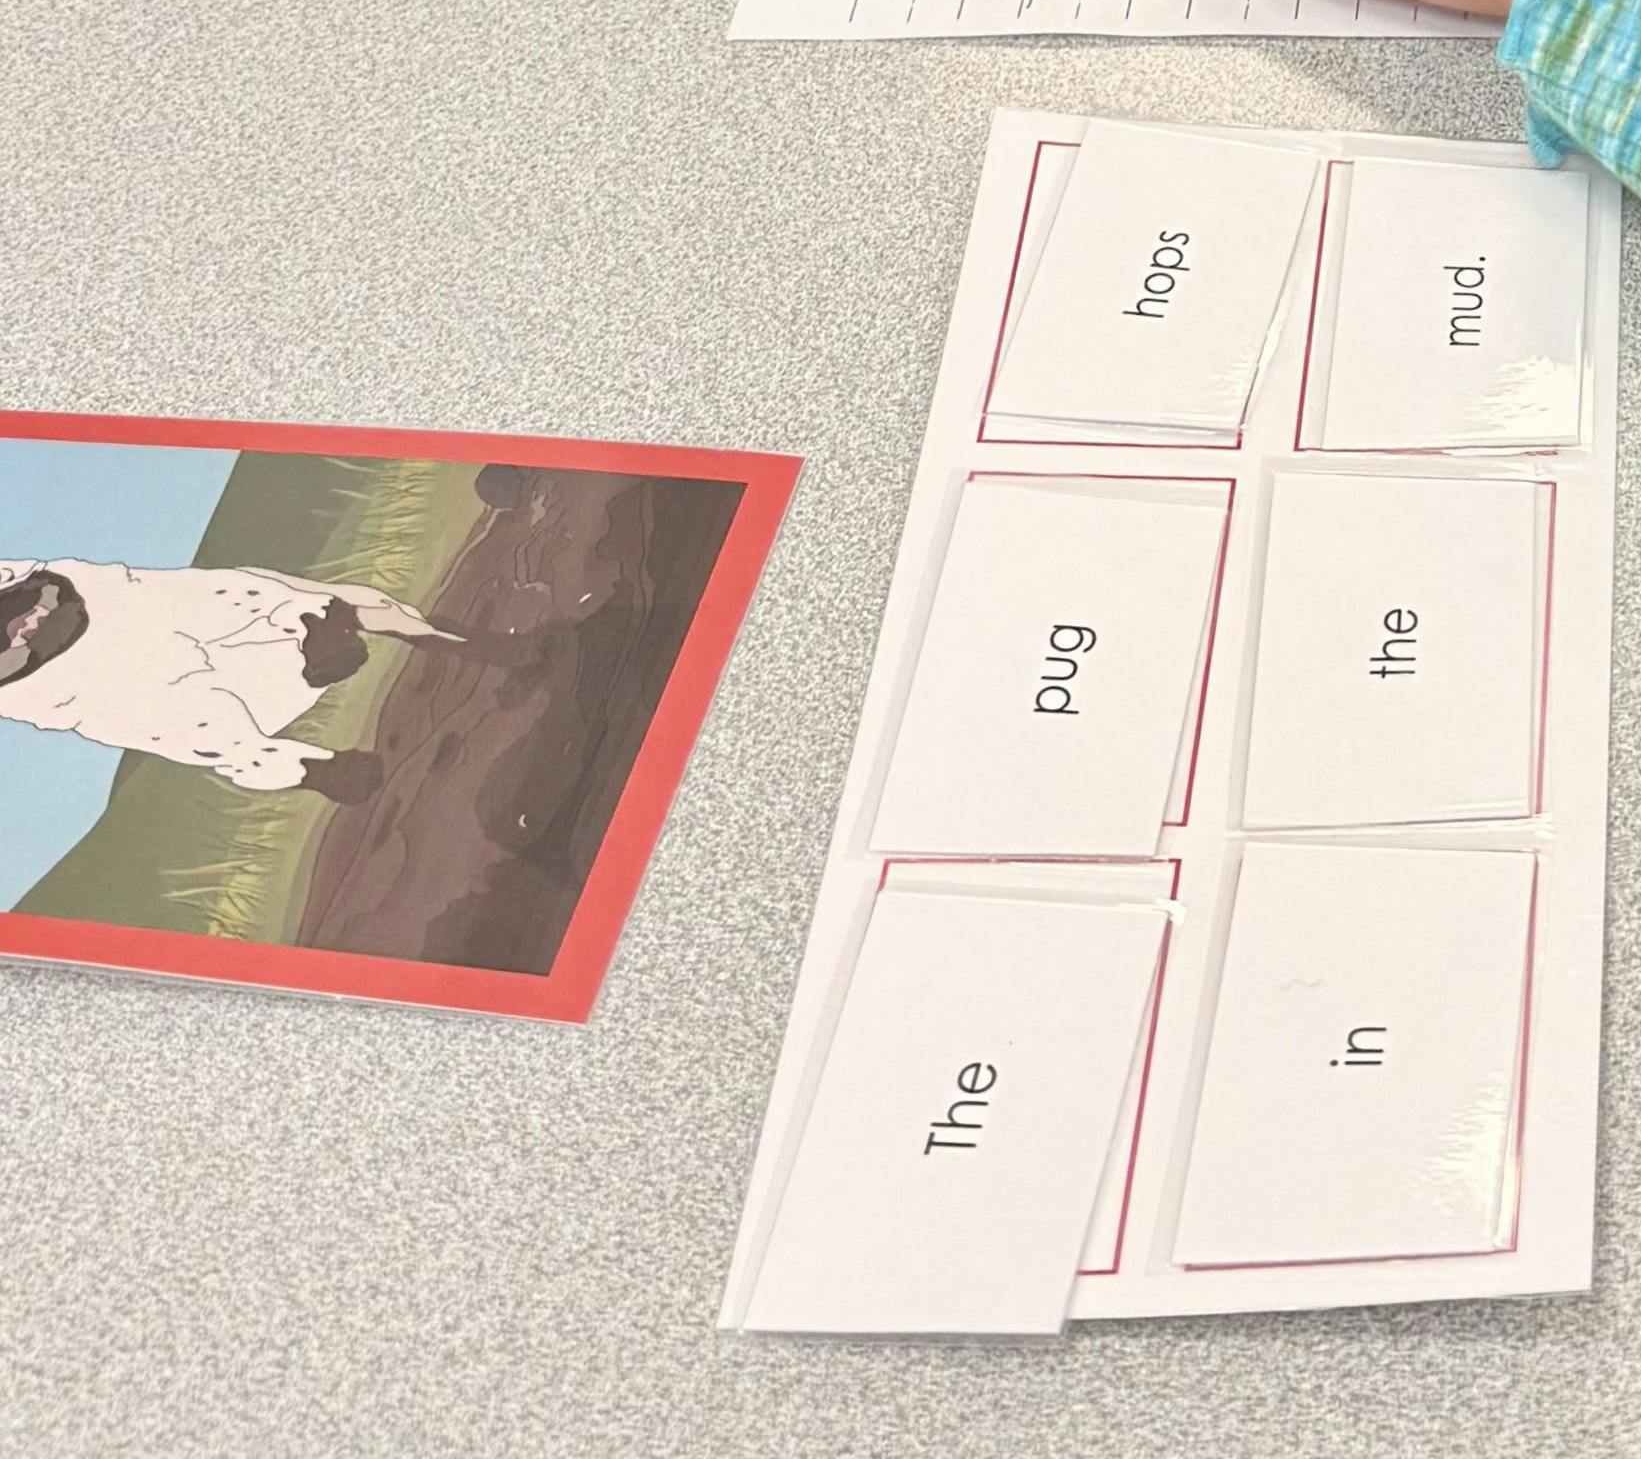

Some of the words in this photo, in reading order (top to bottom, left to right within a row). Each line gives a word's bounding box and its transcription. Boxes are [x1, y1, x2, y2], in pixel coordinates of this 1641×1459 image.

[924, 1061, 997, 1155] The
[1033, 623, 1097, 716] pug
[1122, 229, 1190, 319] hops
[1330, 1025, 1387, 1068] in
[1369, 607, 1418, 680] the
[1443, 255, 1487, 347] mud.
